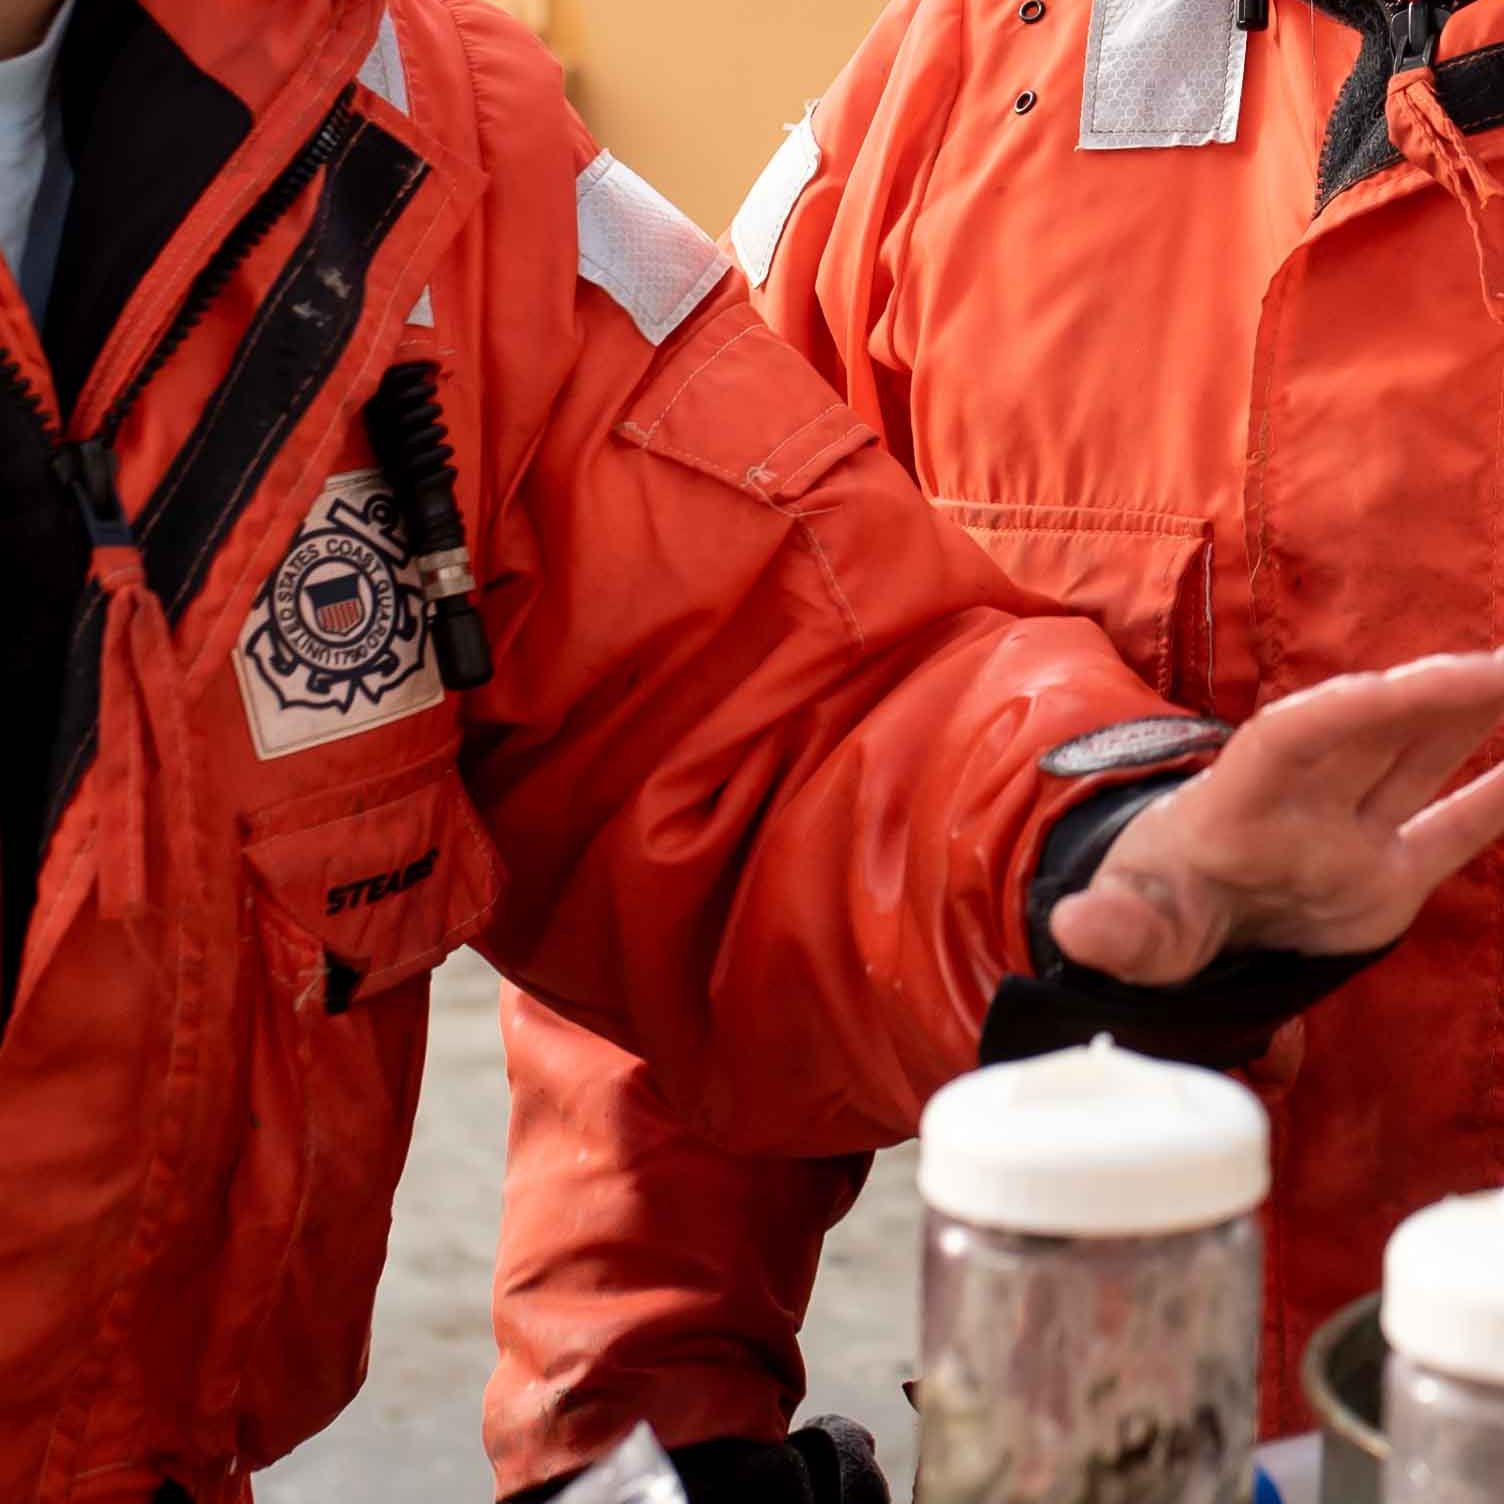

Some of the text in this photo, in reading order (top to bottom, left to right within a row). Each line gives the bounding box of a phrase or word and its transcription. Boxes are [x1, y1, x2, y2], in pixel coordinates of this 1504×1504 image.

[277, 543, 320, 603] STATES
[325, 538, 385, 577] COAST
[366, 578, 393, 649] GUARD
[325, 848, 439, 916] STEA
